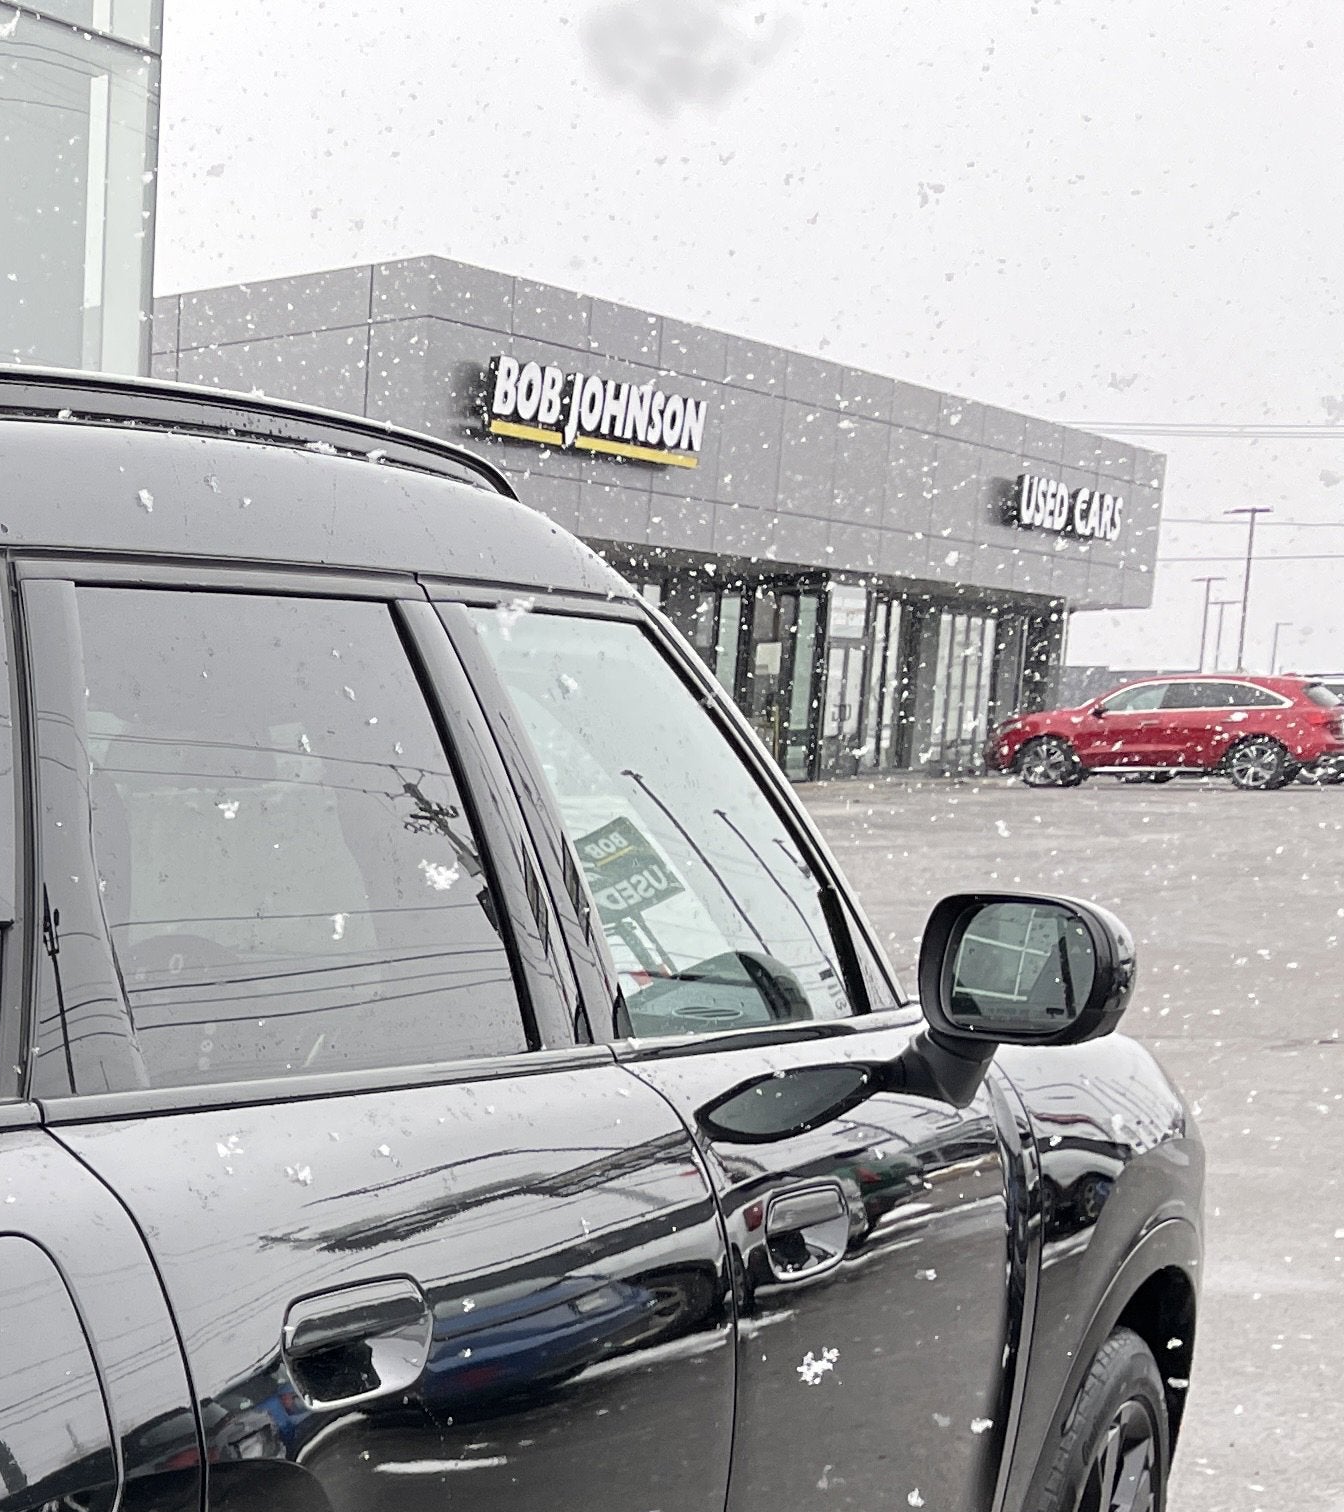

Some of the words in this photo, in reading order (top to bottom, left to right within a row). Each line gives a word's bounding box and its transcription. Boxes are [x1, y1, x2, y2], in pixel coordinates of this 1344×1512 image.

[492, 355, 563, 424] BOB
[565, 371, 707, 452] JOHNSON
[1020, 474, 1069, 531] USED
[1074, 487, 1124, 541] CARS
